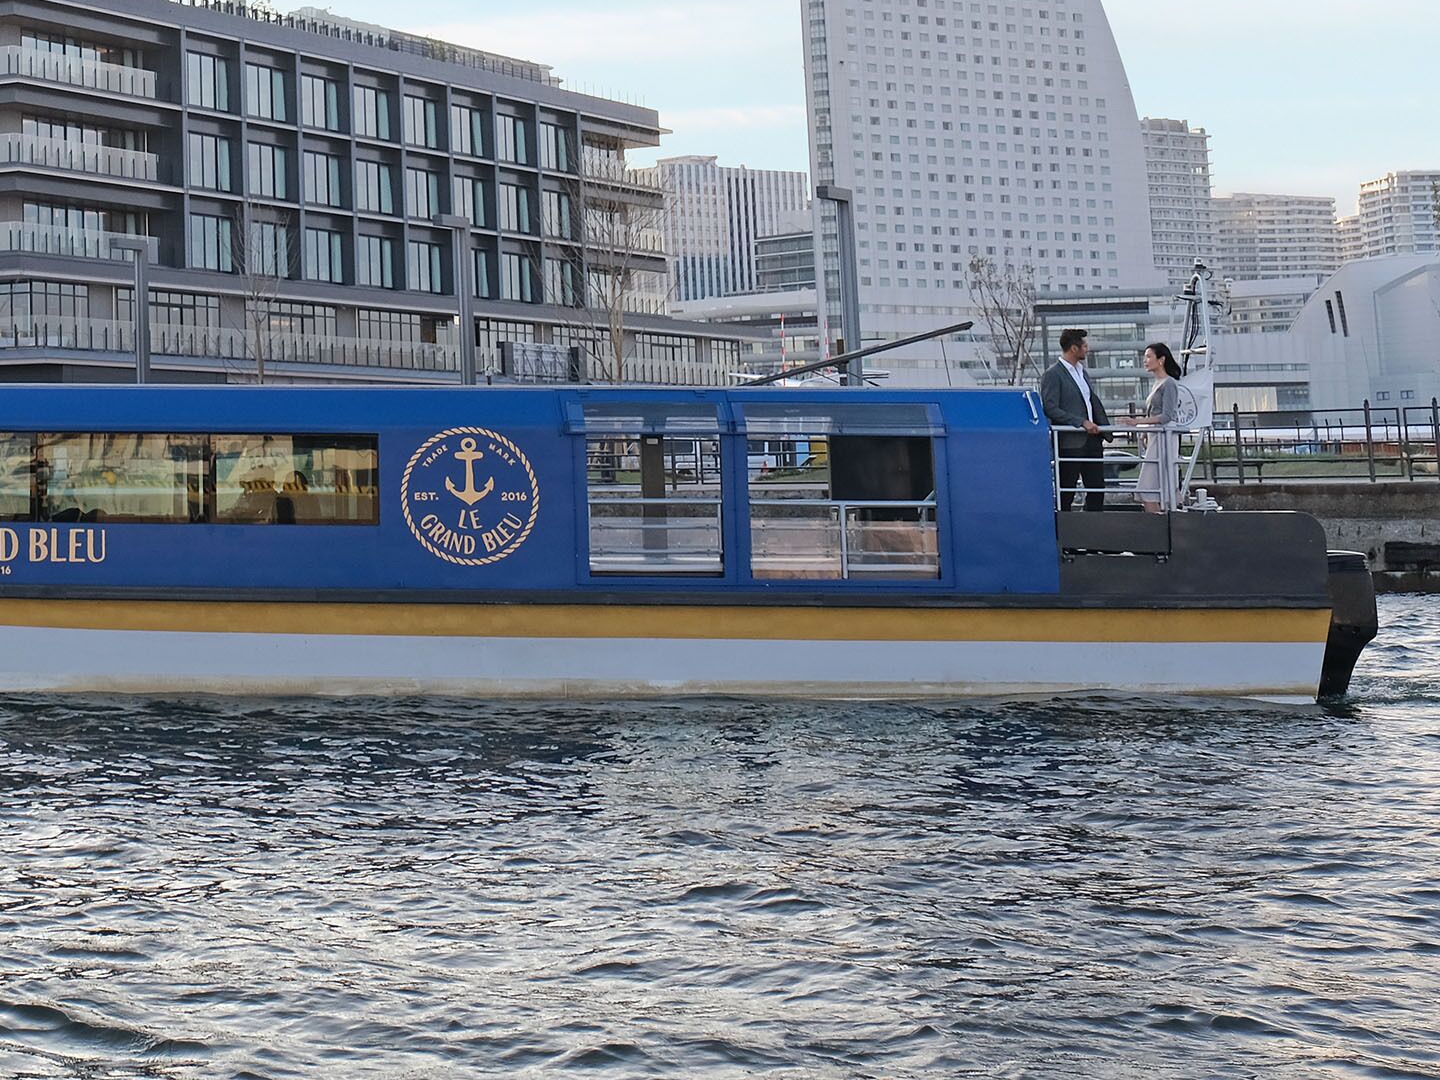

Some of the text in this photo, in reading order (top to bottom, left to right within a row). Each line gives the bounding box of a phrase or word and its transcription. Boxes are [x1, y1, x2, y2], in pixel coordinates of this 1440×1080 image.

[422, 443, 516, 468] TRADE MARK
[414, 491, 527, 501] EST. 2016
[458, 509, 483, 530] LE
[28, 528, 106, 563] BLEU
[420, 512, 523, 555] GRAND BLEU
